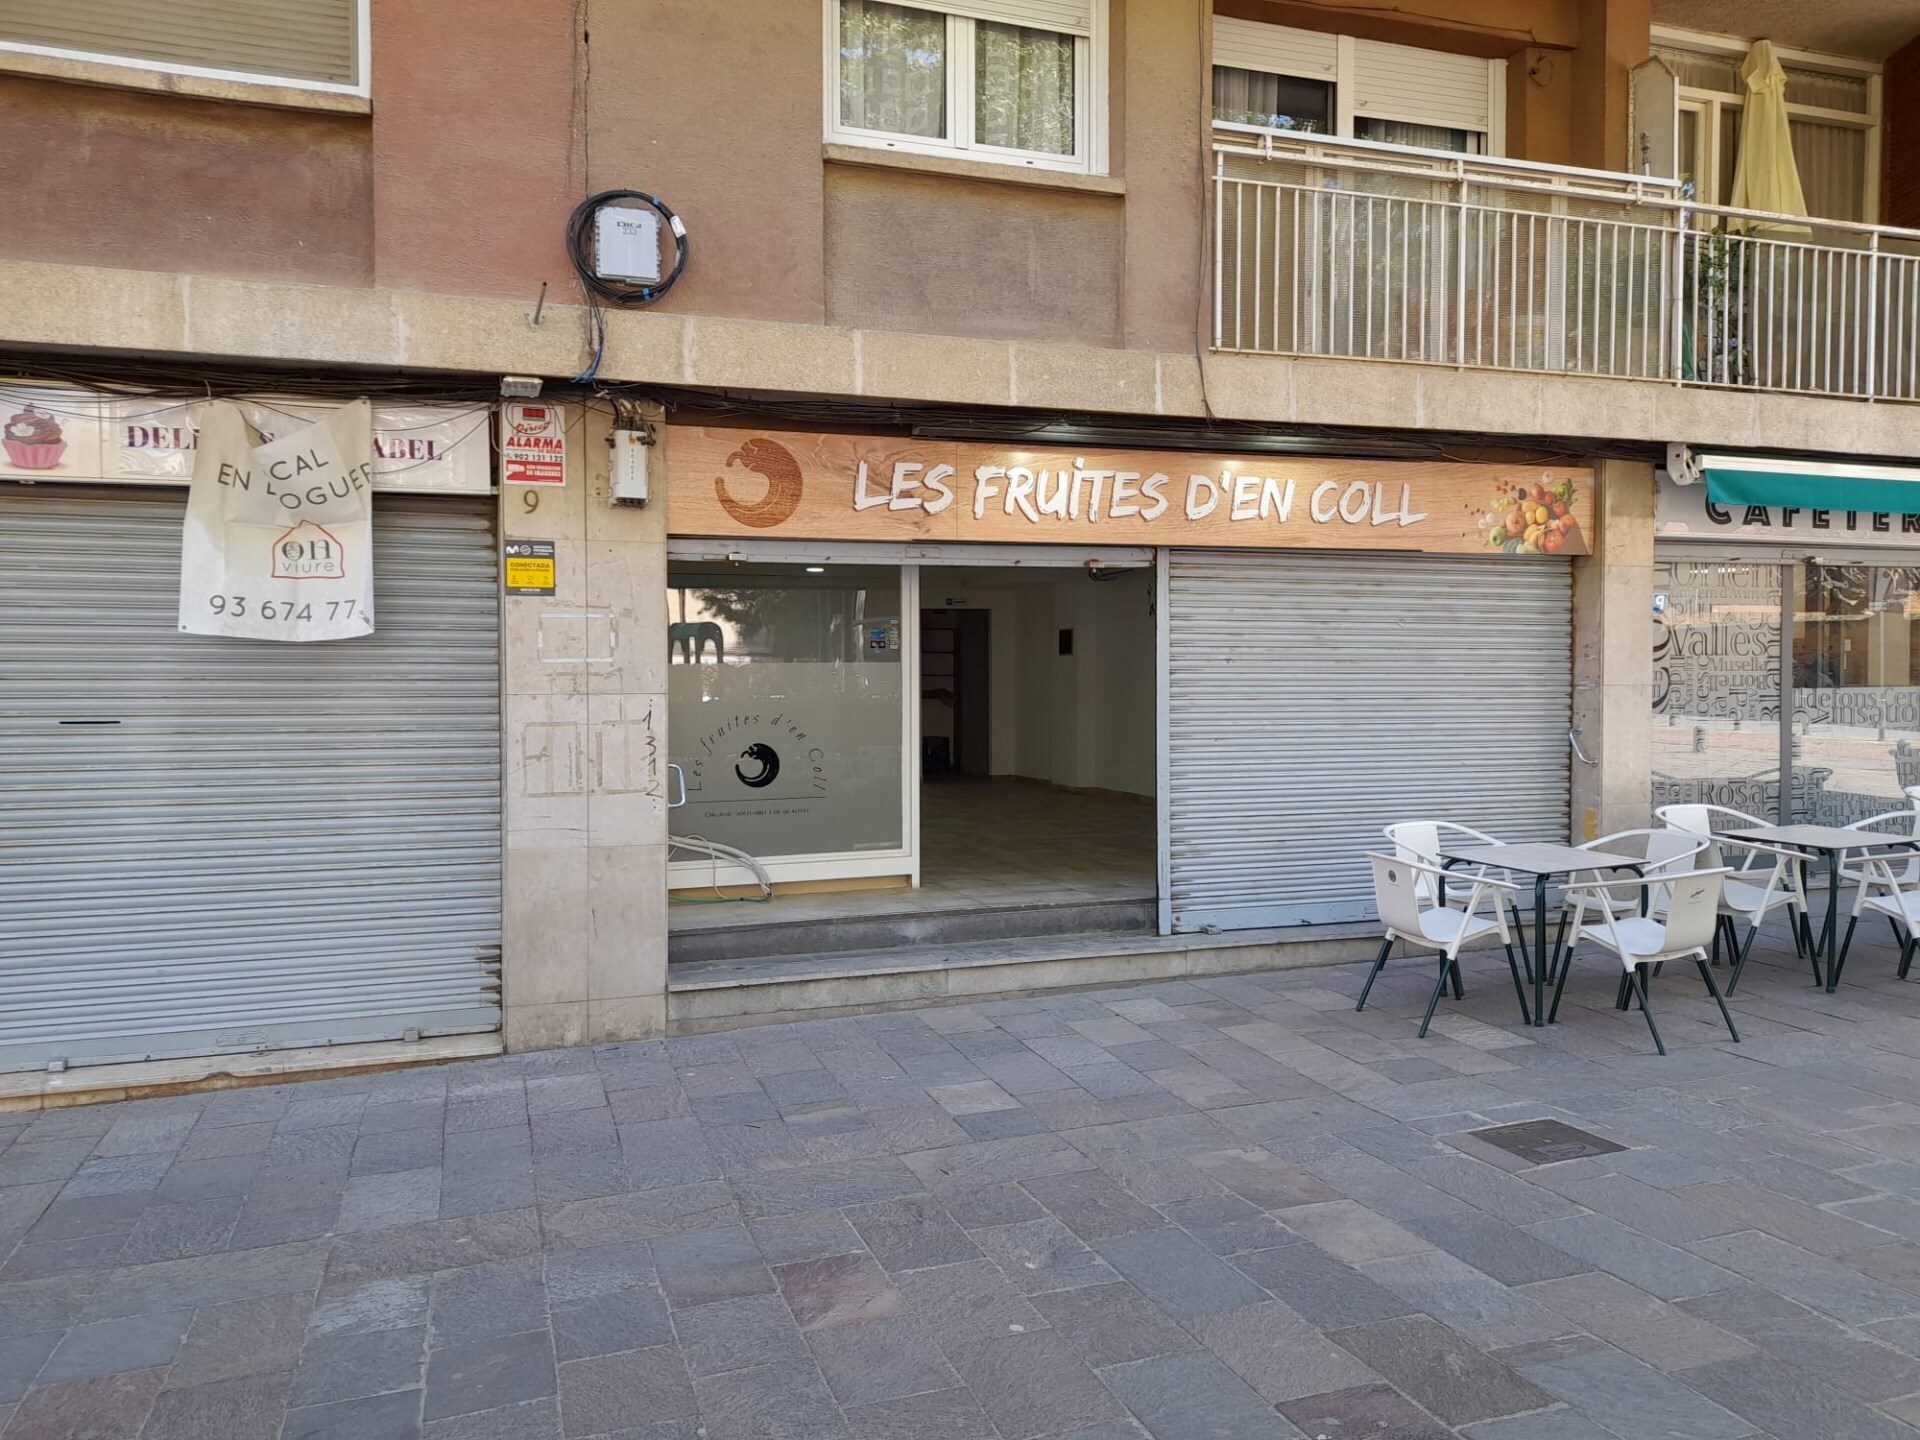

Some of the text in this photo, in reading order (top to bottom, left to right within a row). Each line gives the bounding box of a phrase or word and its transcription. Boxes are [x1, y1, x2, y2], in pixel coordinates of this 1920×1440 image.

[506, 437, 563, 449] ALARMA
[217, 463, 251, 491] EN
[523, 490, 539, 514] 9
[853, 460, 955, 515] LES
[1185, 470, 1297, 524] D'EN
[1310, 480, 1429, 527] COLL
[281, 539, 333, 561] on
[281, 560, 335, 574] viure
[209, 595, 246, 617] 93
[261, 600, 312, 622] 674
[326, 599, 356, 621] 77
[1671, 622, 1767, 657] Vallès
[1710, 657, 1766, 672] Musella
[687, 713, 828, 791] Les fruites d'en Coll
